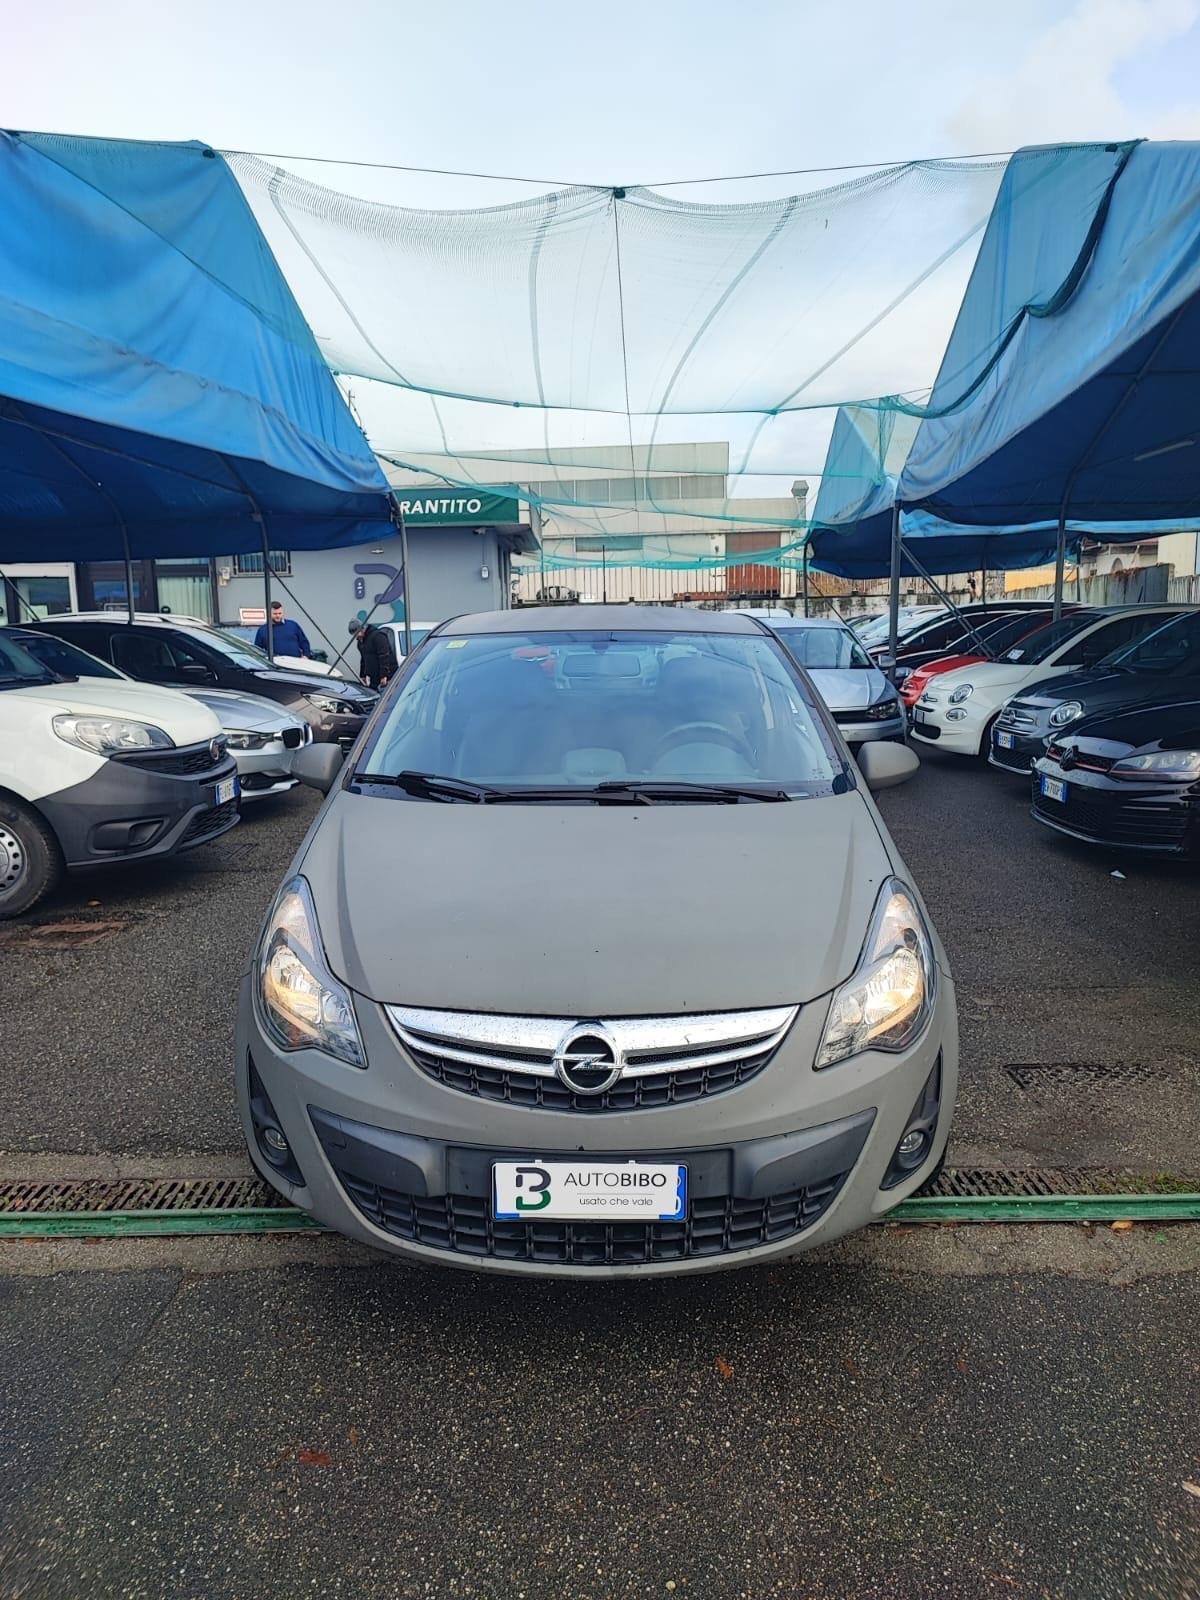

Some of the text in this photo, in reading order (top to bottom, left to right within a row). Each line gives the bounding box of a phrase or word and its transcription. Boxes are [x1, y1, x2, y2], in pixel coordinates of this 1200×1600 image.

[563, 1172, 667, 1188] AUTOBIBO
[579, 1197, 653, 1207] usato che vale
